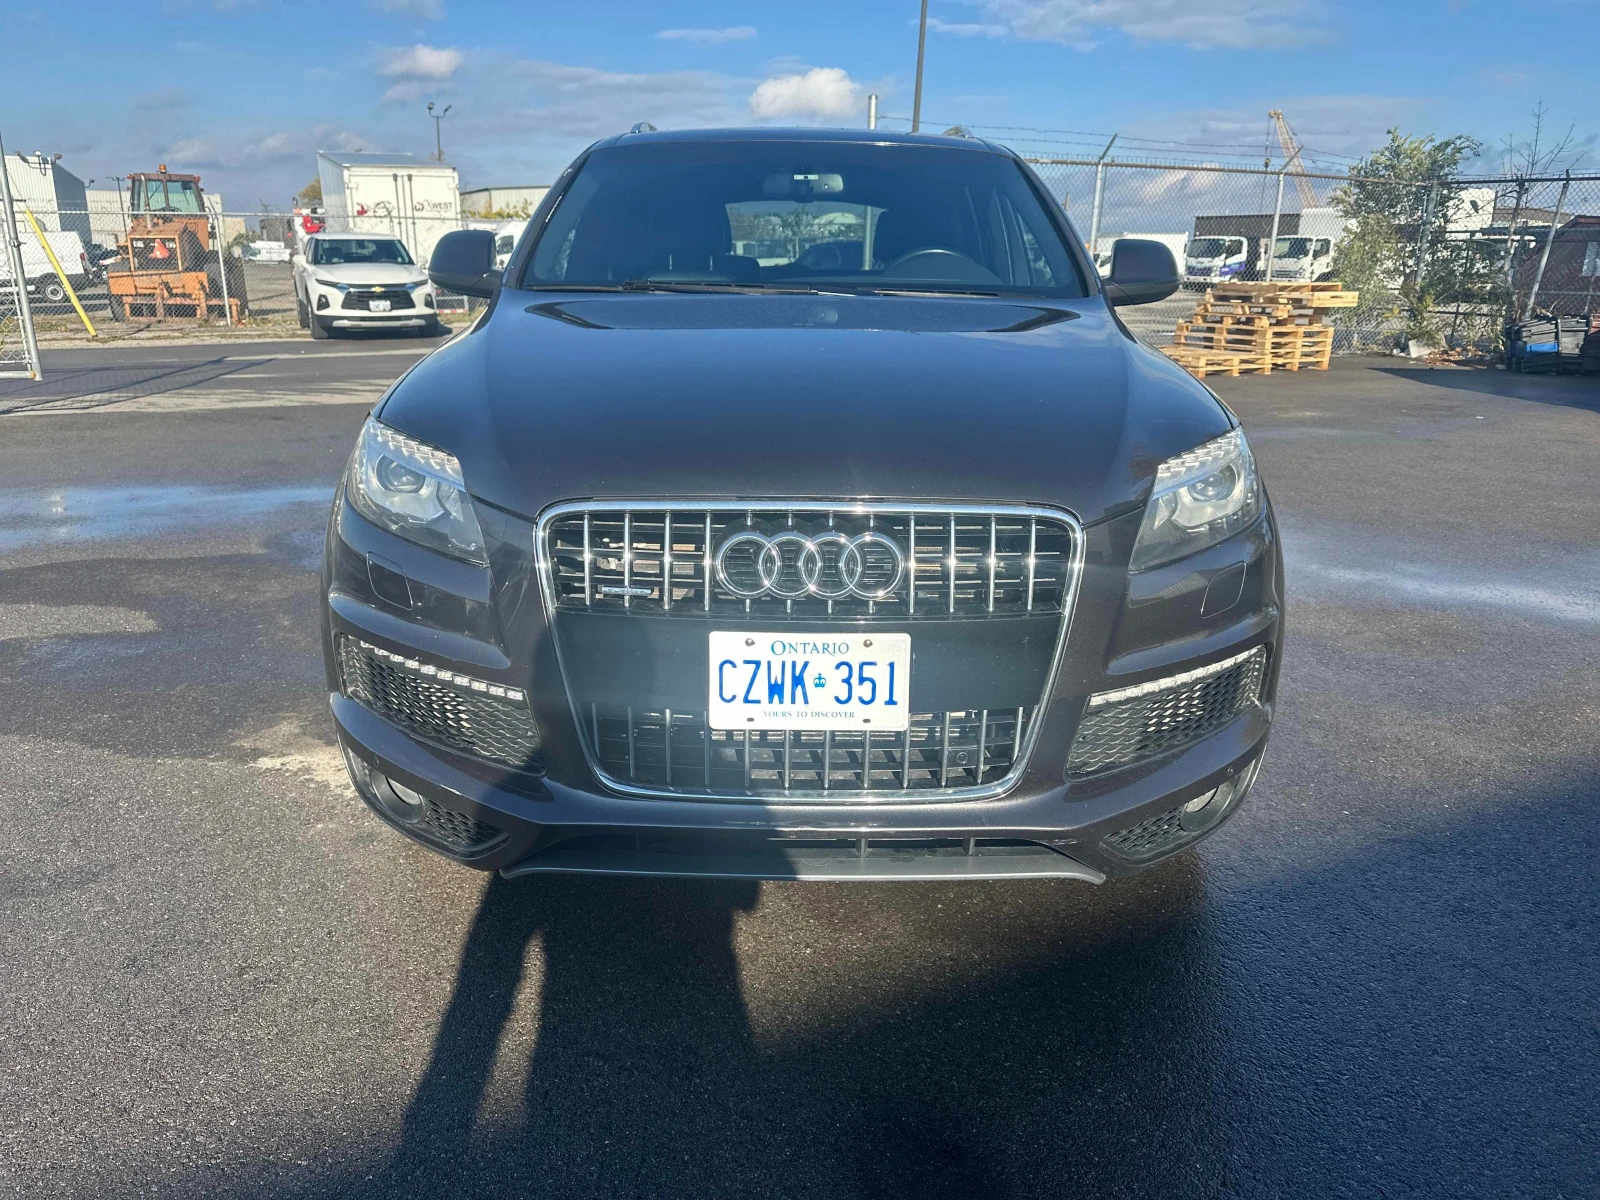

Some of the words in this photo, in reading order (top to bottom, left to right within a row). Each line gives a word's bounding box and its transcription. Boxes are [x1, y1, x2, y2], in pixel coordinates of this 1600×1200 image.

[770, 640, 850, 657] ONTARIO
[718, 659, 810, 705] CZWK
[833, 660, 899, 706] 351
[763, 710, 793, 718] YOURS
[796, 710, 808, 718] TO
[810, 711, 856, 719] DISCOVER
